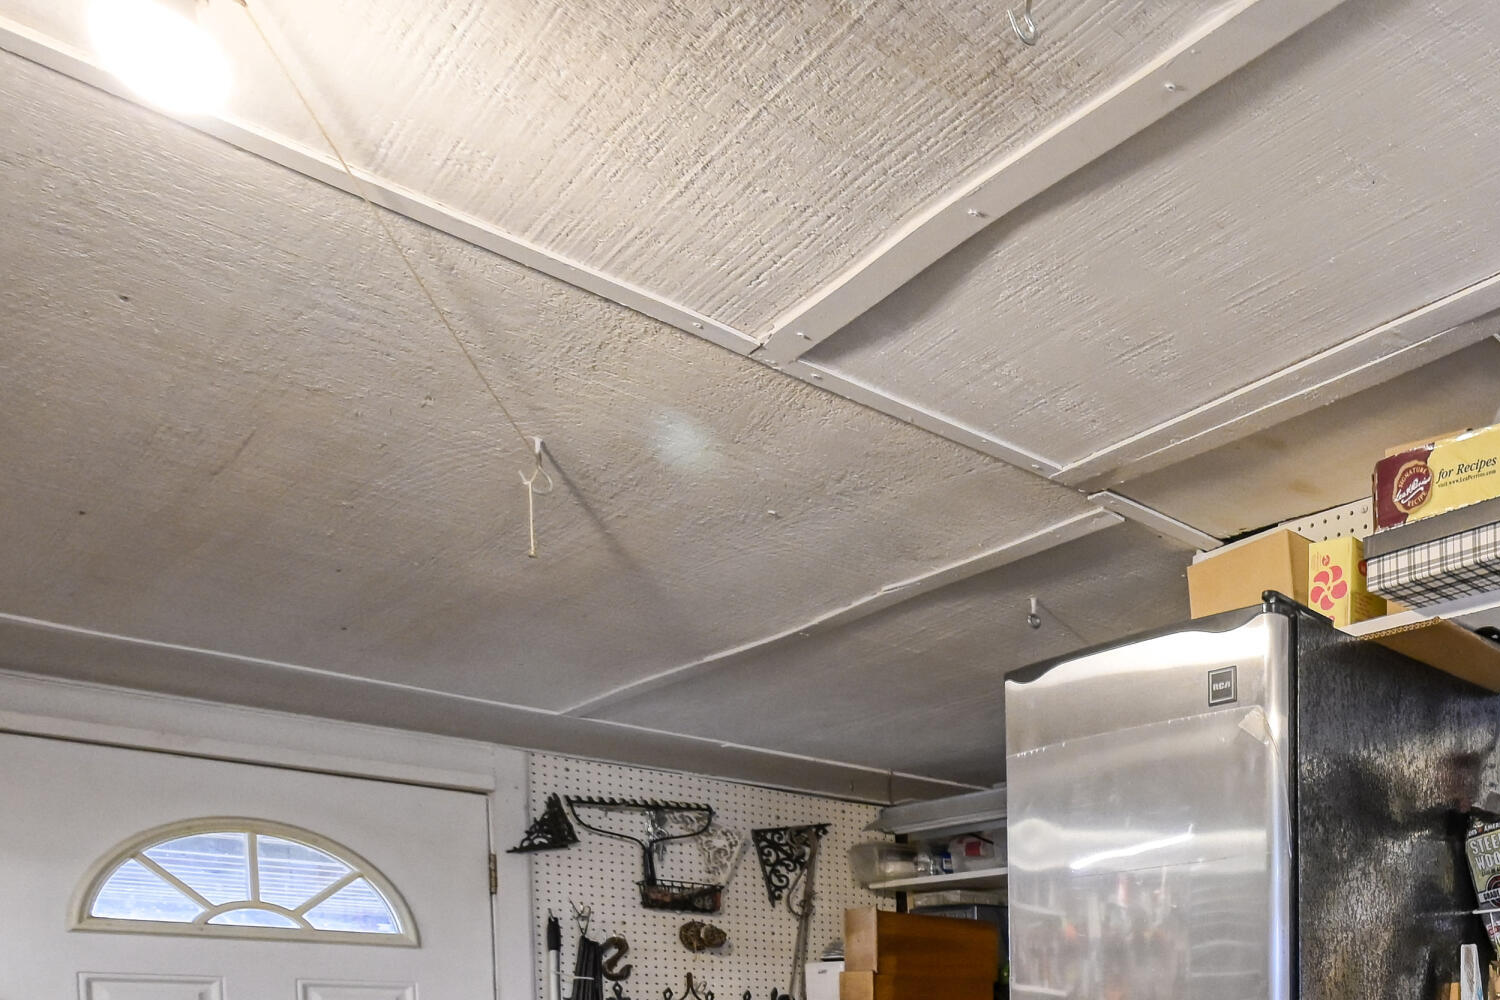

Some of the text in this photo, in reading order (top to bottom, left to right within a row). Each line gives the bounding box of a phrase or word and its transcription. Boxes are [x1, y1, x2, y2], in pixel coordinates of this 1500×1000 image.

[1436, 457, 1497, 484] for Recipes
[1212, 680, 1231, 691] RCA
[1483, 889, 1500, 901] GRADE
